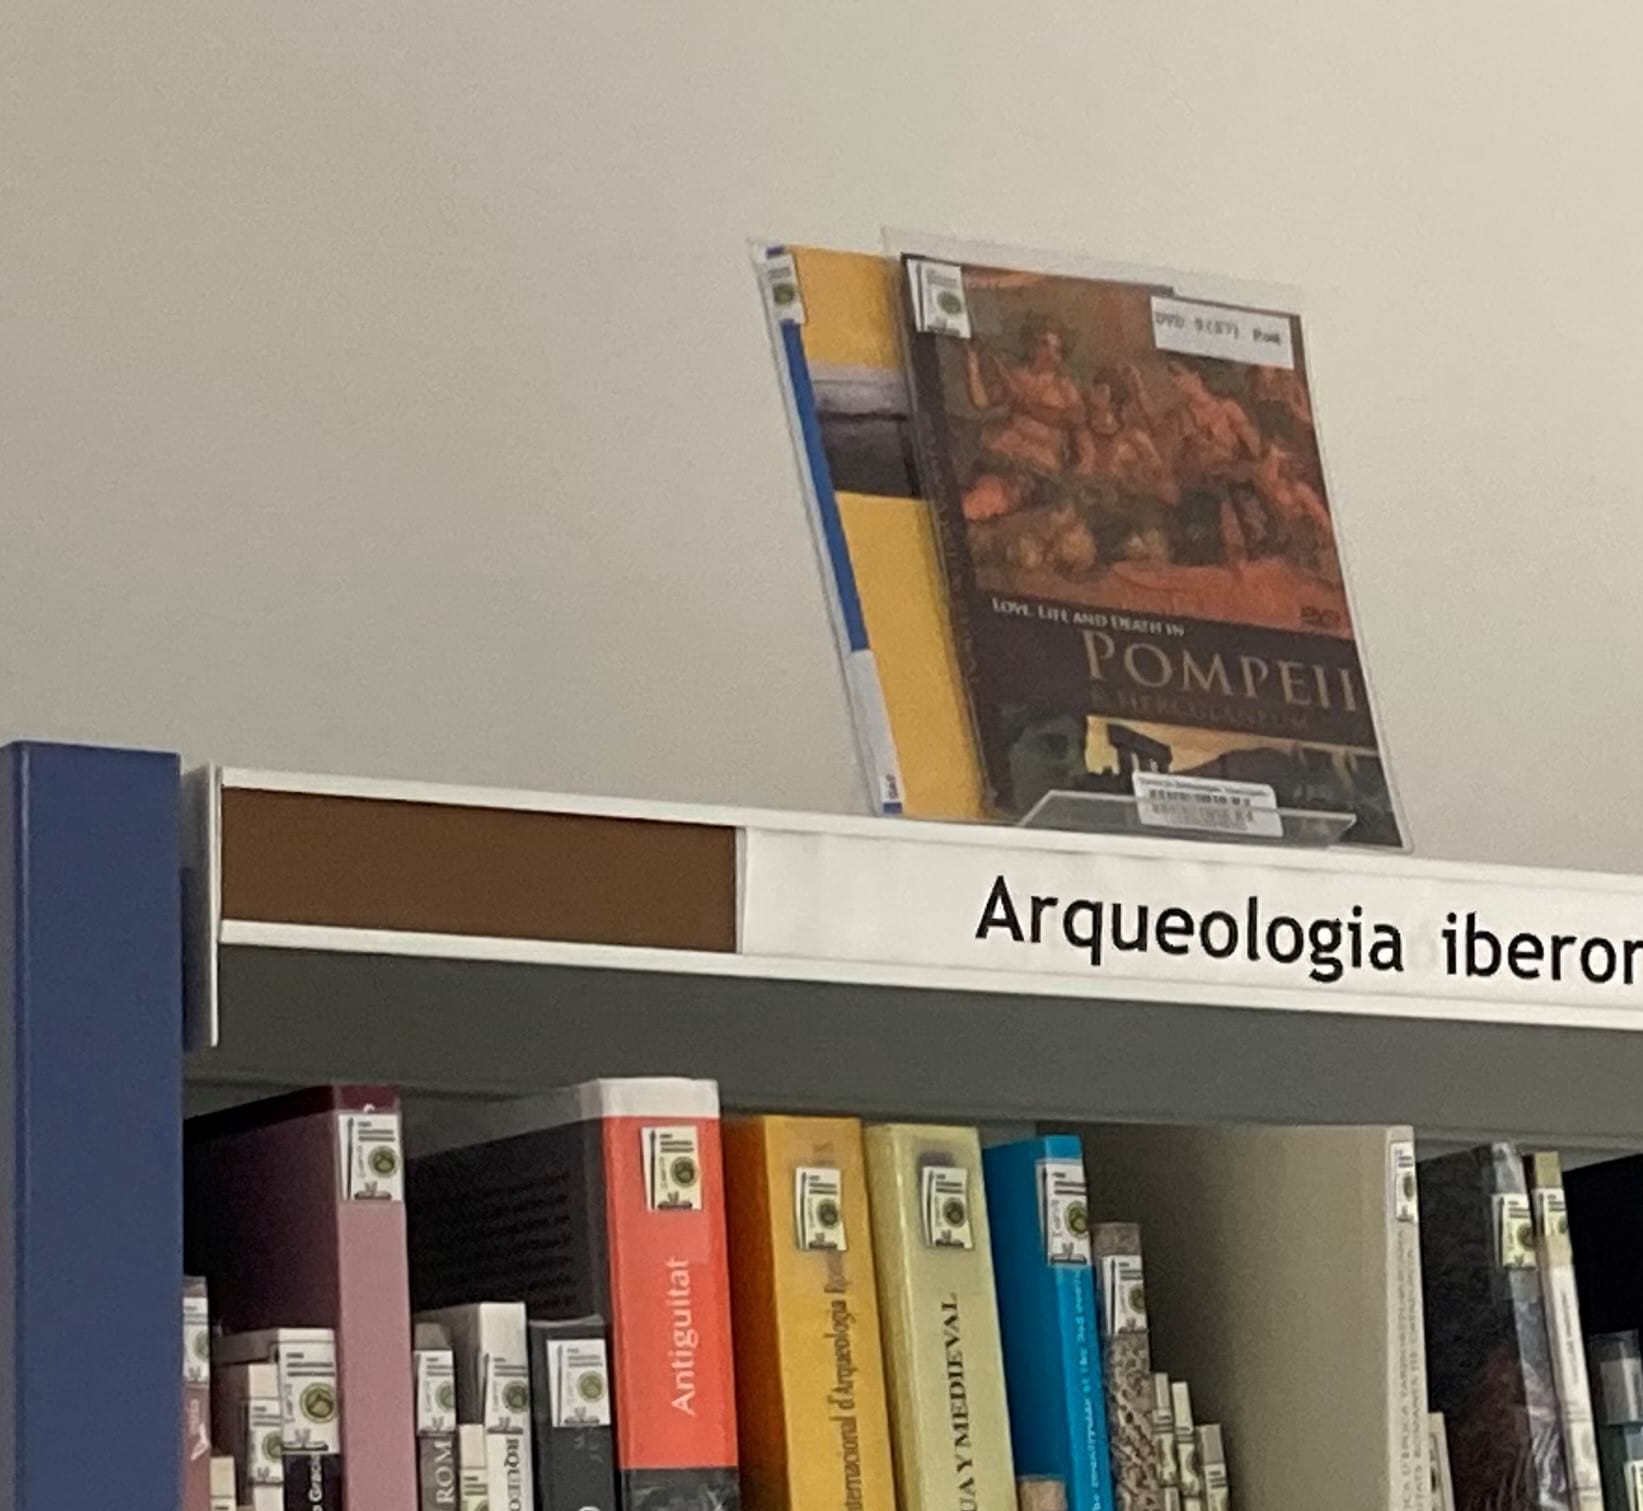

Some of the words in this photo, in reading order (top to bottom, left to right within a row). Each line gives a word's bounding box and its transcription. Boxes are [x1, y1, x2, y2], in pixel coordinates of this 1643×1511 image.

[1083, 629, 1361, 713] POMPEII
[975, 874, 1405, 982] Arqueologia
[665, 1255, 700, 1418] Antiguitat
[822, 1300, 857, 1411] d'Arqueologia
[941, 1292, 971, 1450] MEDIEVAL
[433, 1441, 455, 1504] ROM
[953, 1452, 973, 1475] Y
